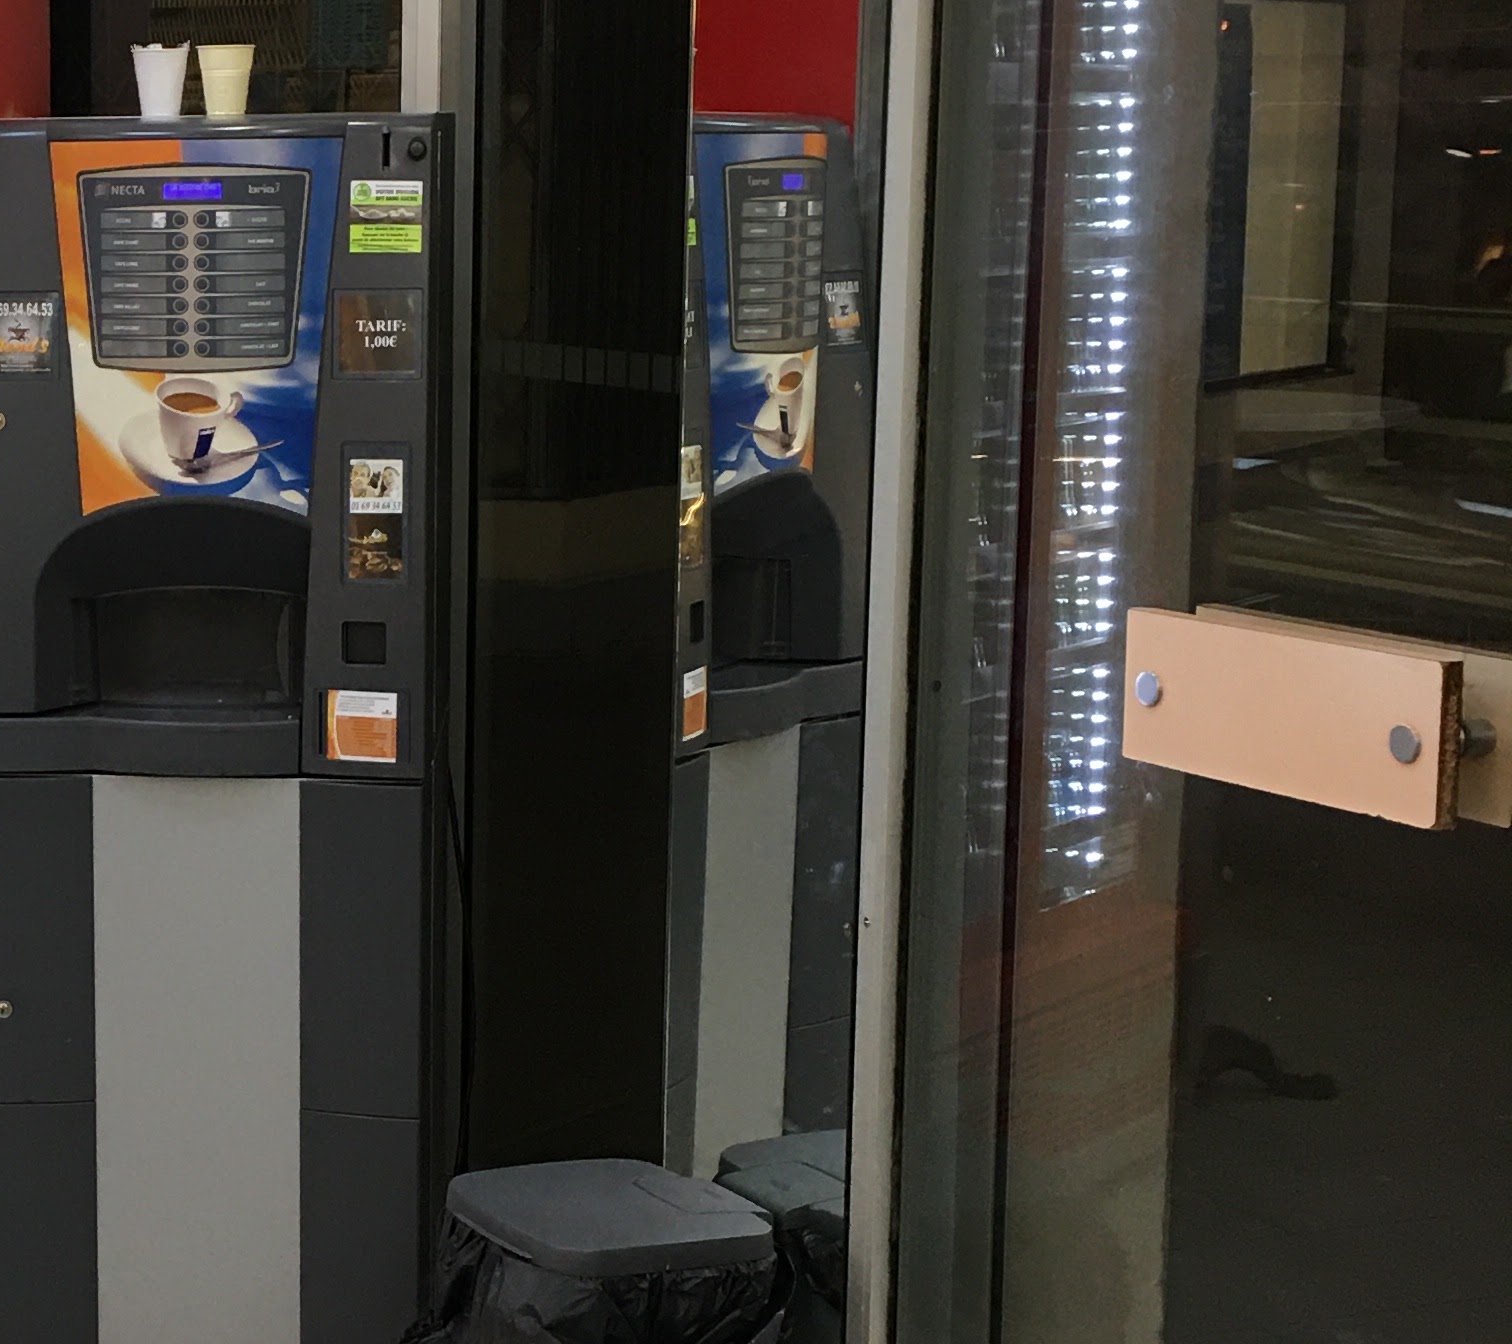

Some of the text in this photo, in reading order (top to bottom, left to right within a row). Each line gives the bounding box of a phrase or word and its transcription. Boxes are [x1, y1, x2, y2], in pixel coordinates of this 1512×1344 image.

[111, 184, 146, 196] NECTA
[355, 319, 407, 332] TARIF:
[364, 335, 398, 349] 1,00€
